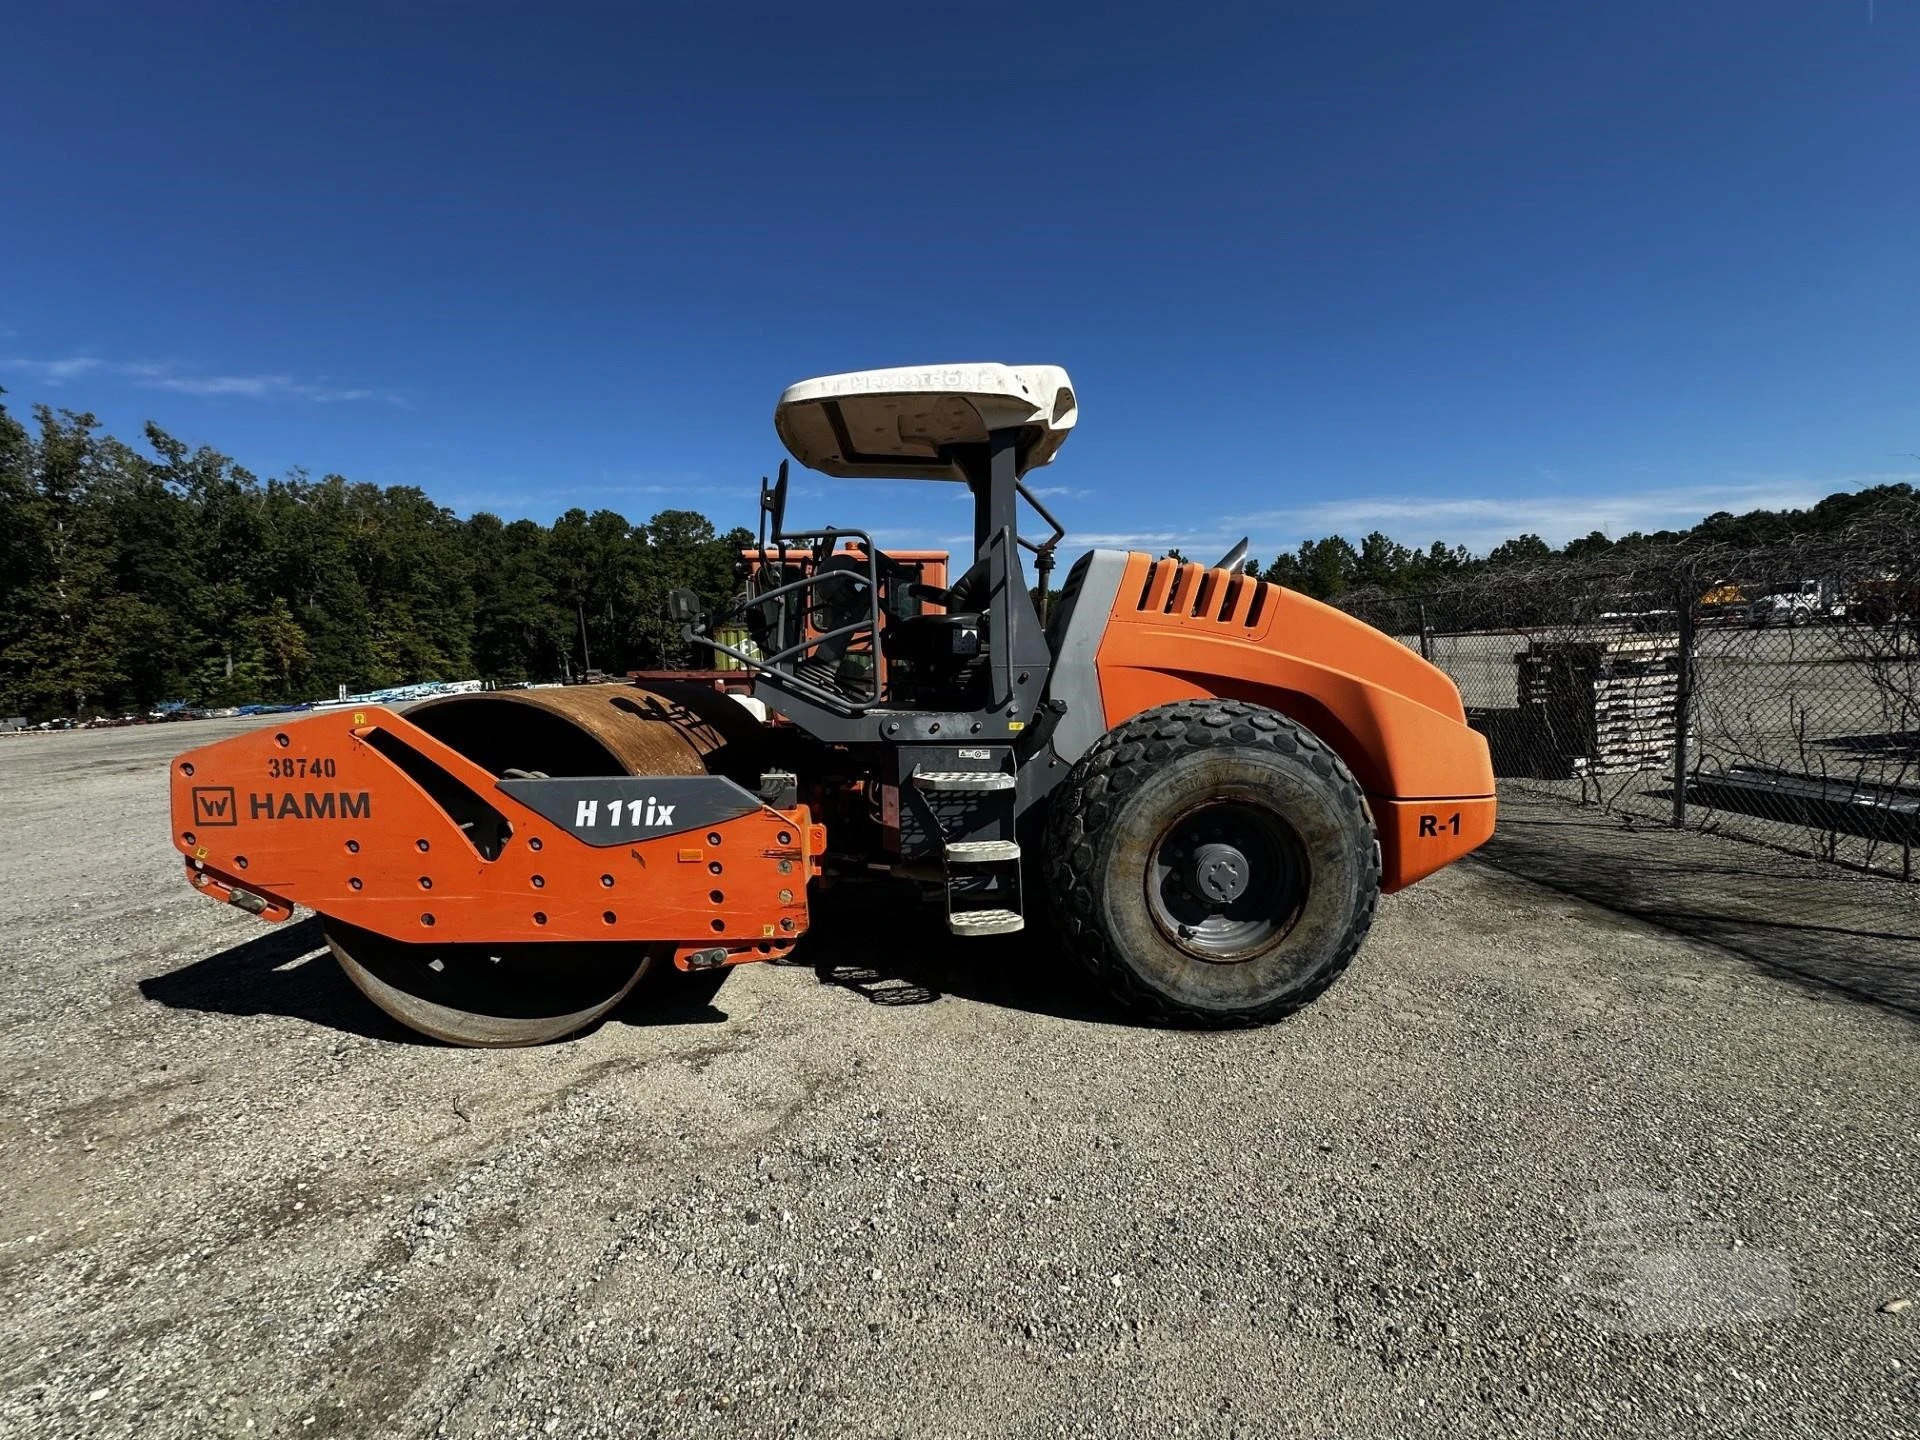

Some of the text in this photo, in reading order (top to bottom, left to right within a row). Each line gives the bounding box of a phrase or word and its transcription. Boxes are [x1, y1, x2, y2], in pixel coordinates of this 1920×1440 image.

[268, 758, 336, 778] 38740
[250, 792, 372, 820] HAMM
[575, 796, 676, 827] H 11ix
[1418, 812, 1461, 838] R-1
